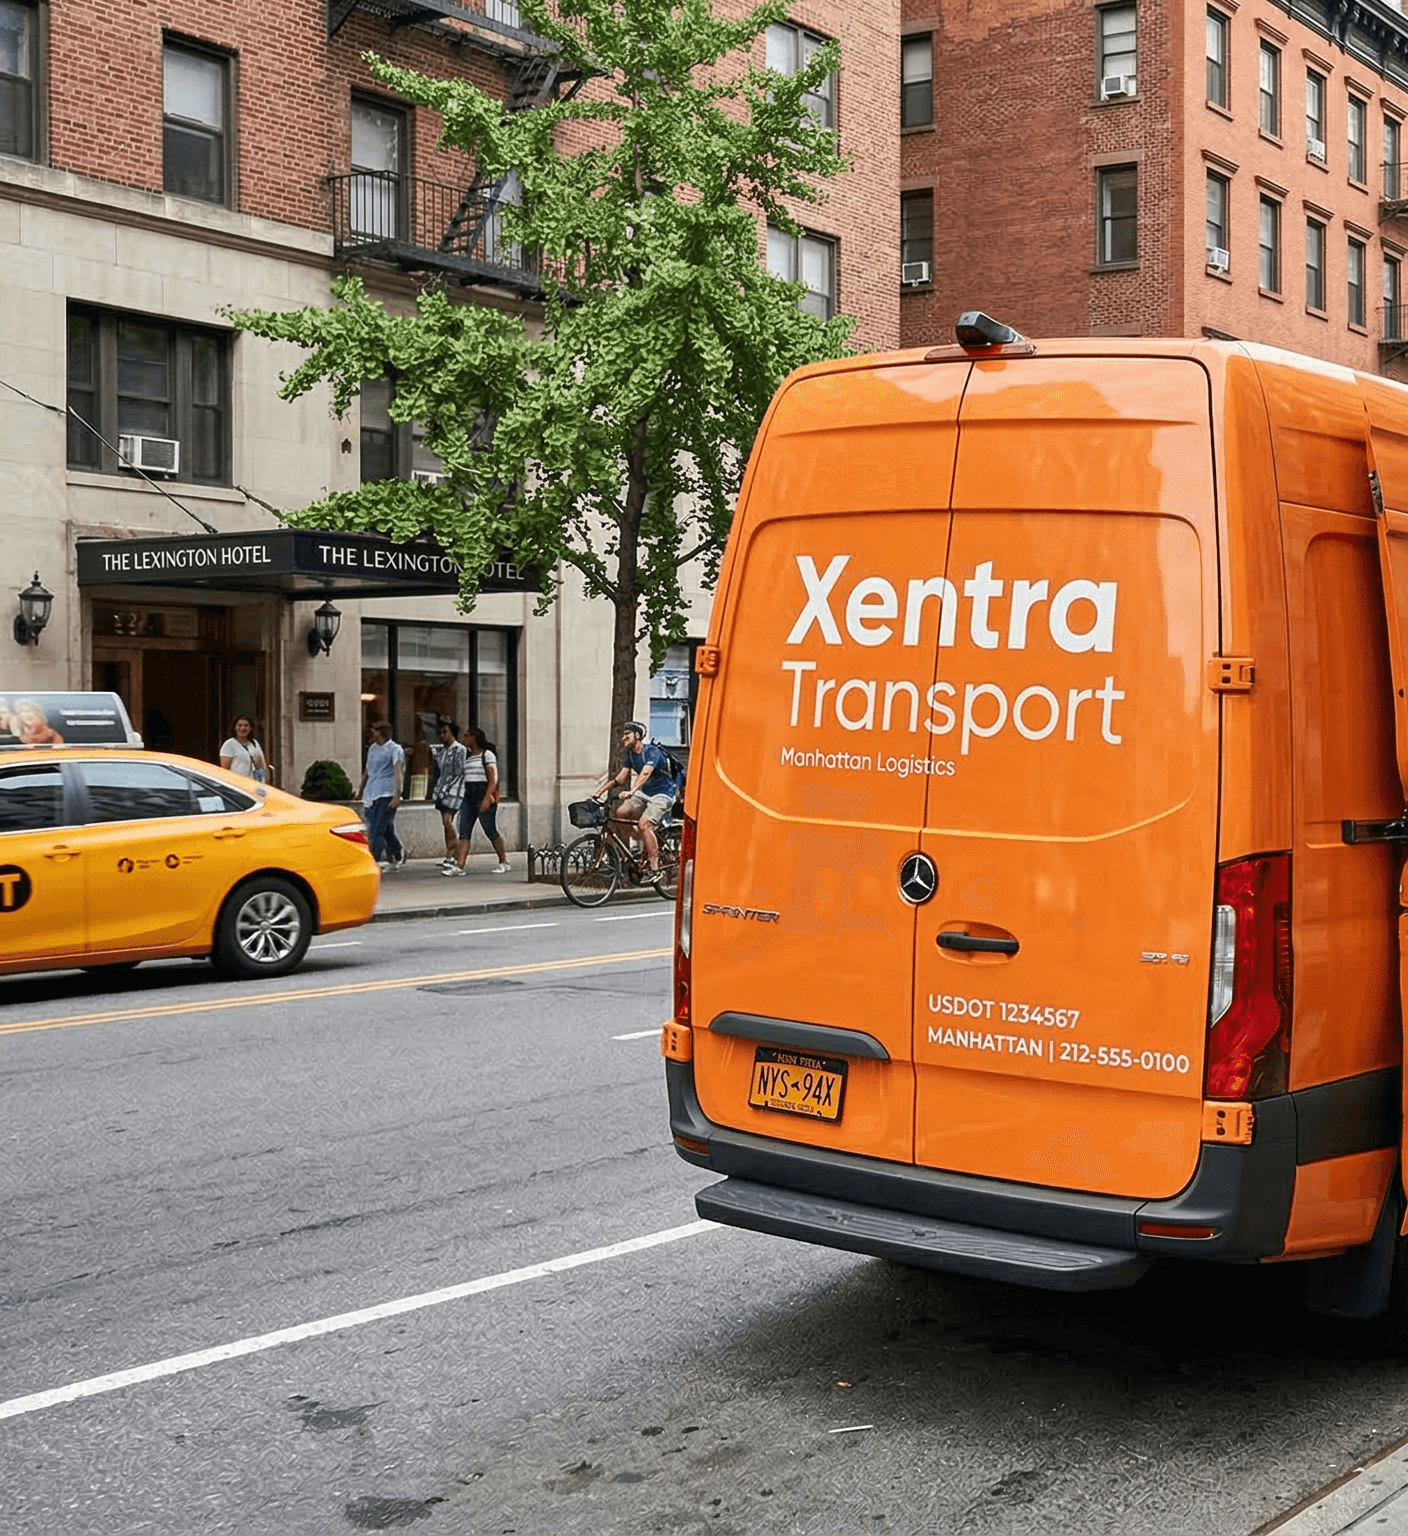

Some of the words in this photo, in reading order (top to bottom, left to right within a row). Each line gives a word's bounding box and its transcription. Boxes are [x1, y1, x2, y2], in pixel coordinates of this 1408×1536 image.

[102, 553, 131, 571] THE
[134, 548, 218, 570] LEXINGTON
[221, 545, 272, 565] HOTEL
[318, 545, 358, 567] THE
[480, 561, 525, 580] OTEL
[785, 554, 1119, 654] Xentra
[781, 659, 1127, 757] Transport
[781, 746, 872, 771] Manhattan
[877, 751, 956, 778] Logistics
[928, 993, 996, 1020] USDOT
[998, 1002, 1081, 1030] 1234567
[928, 1019, 1044, 1058] MANHATTAN
[1059, 1042, 1190, 1074] 212-555-0100
